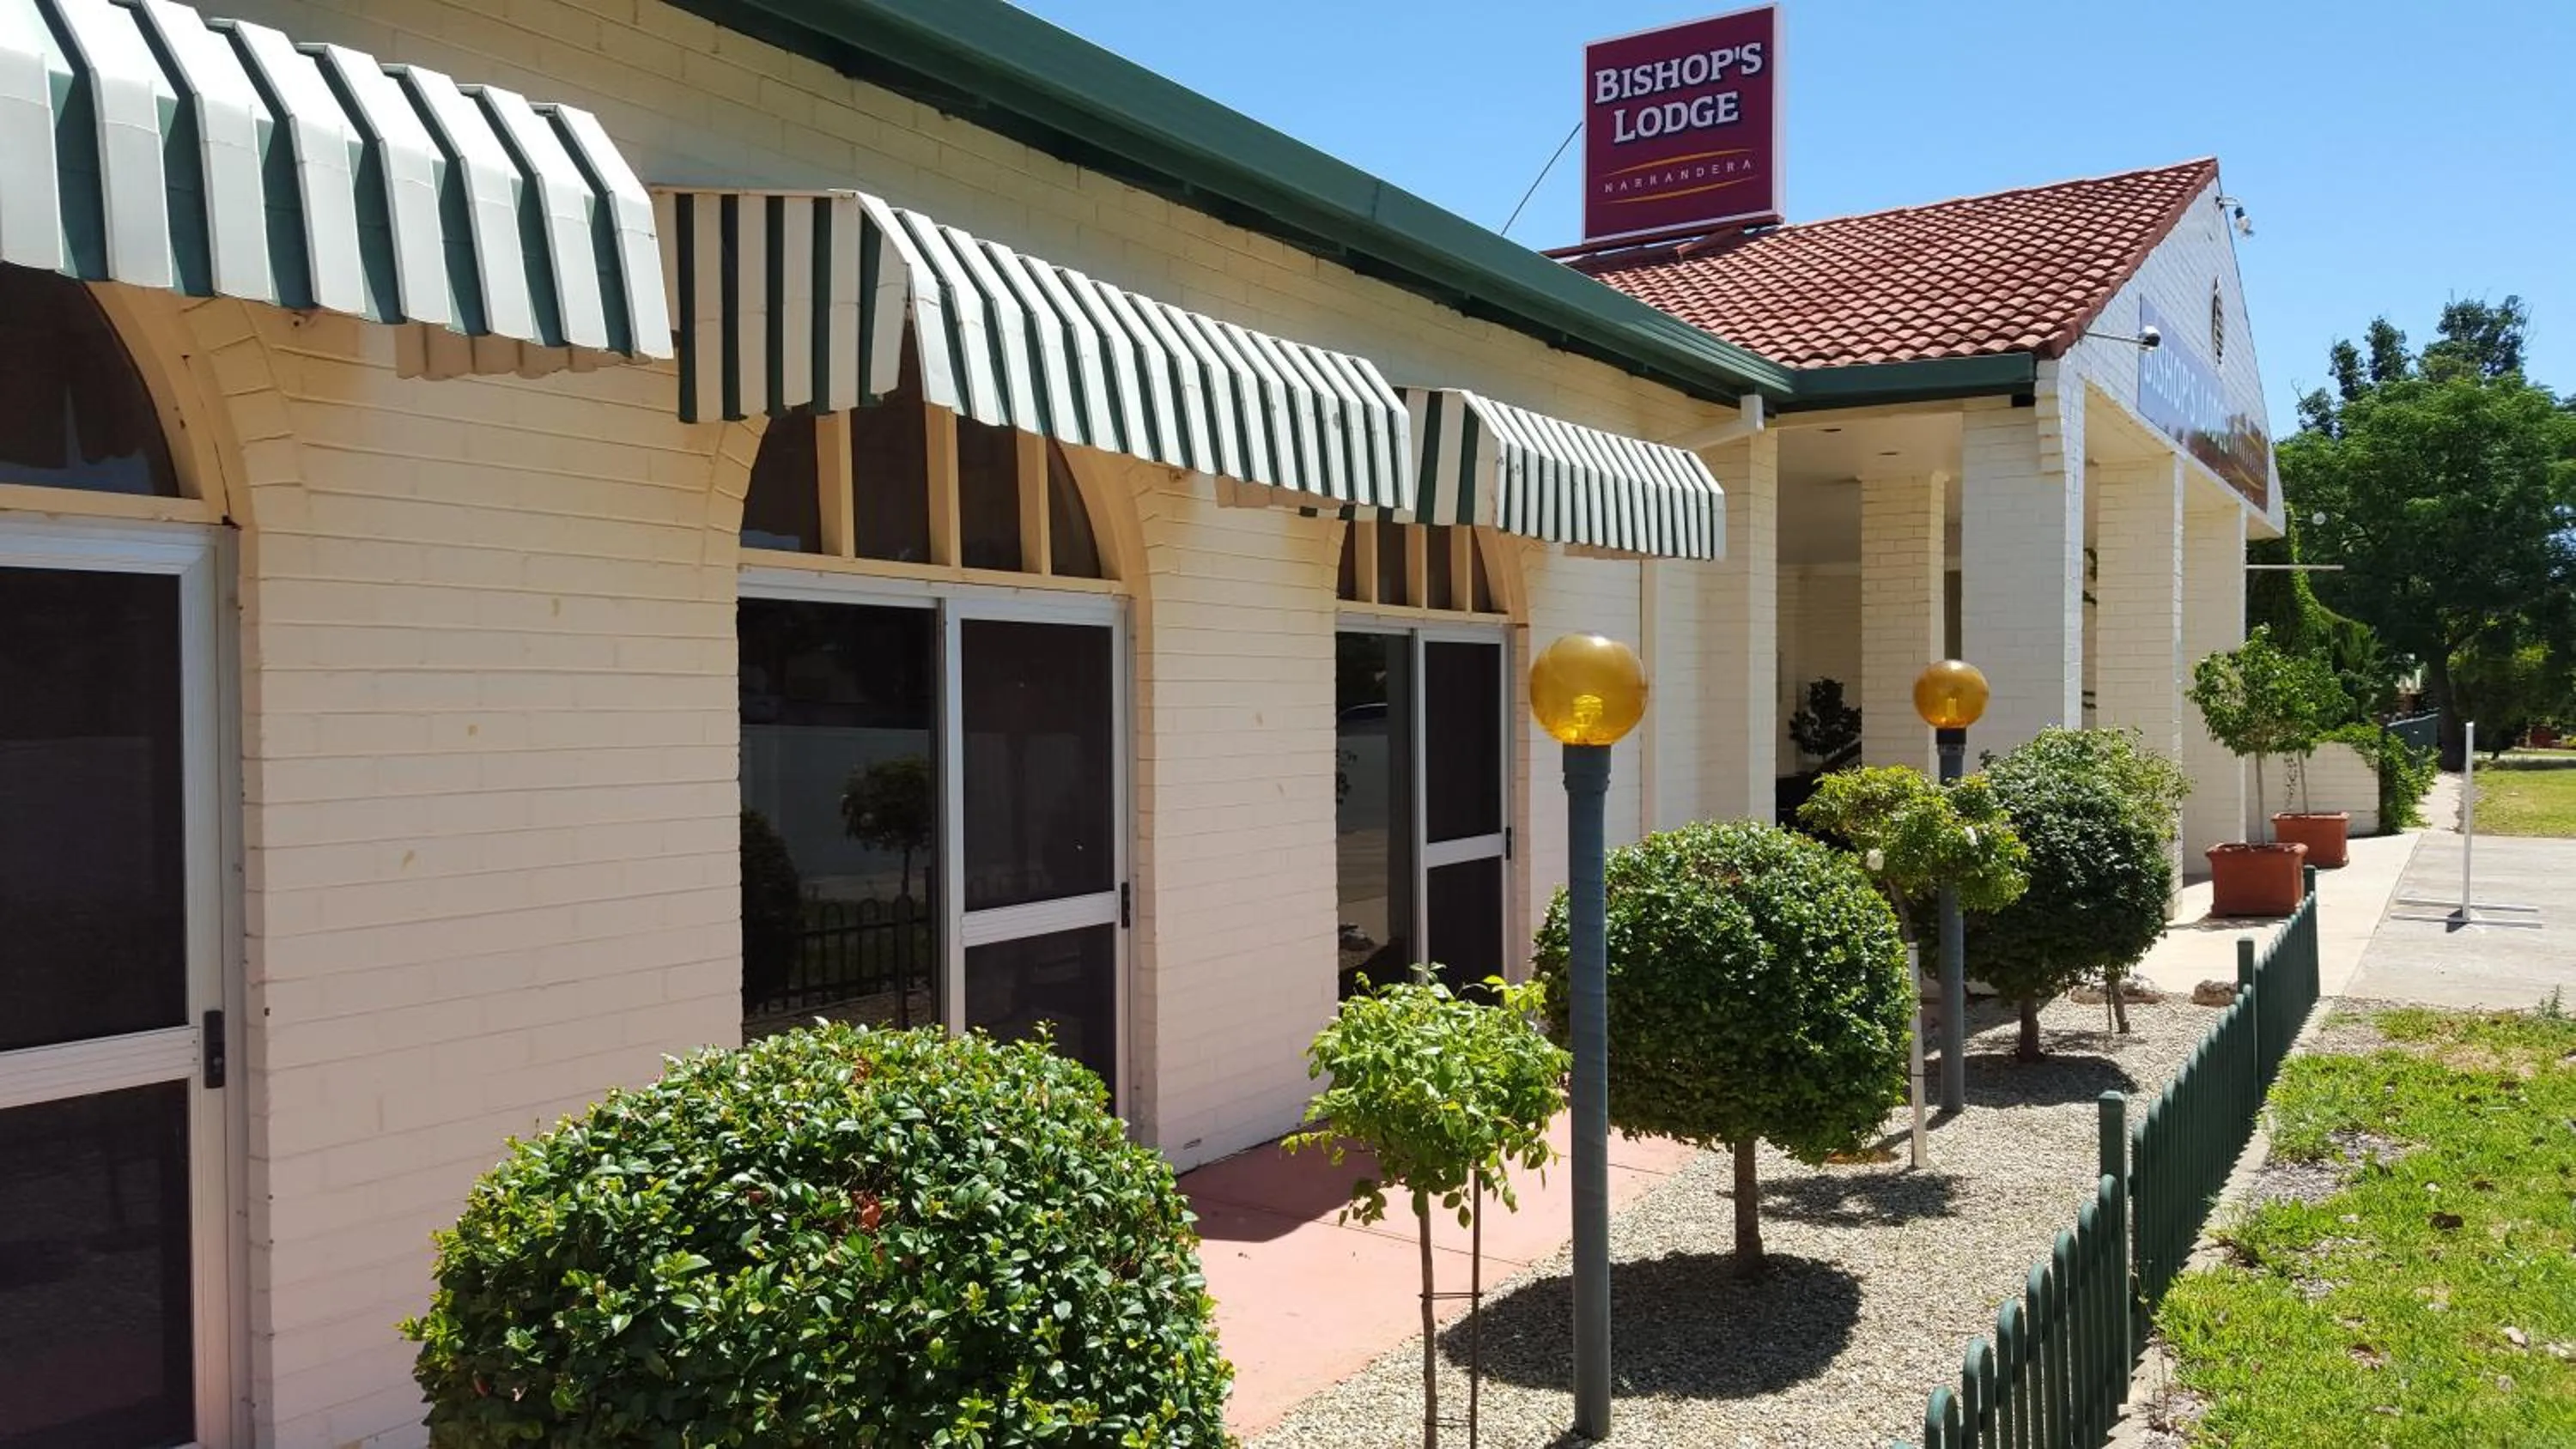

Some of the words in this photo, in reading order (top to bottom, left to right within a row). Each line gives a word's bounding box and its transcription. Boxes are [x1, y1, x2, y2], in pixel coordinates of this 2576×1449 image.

[1595, 42, 1763, 104] BISHOP'S
[1613, 91, 1739, 143] LODGE
[1604, 159, 1752, 193] NARRANDERA
